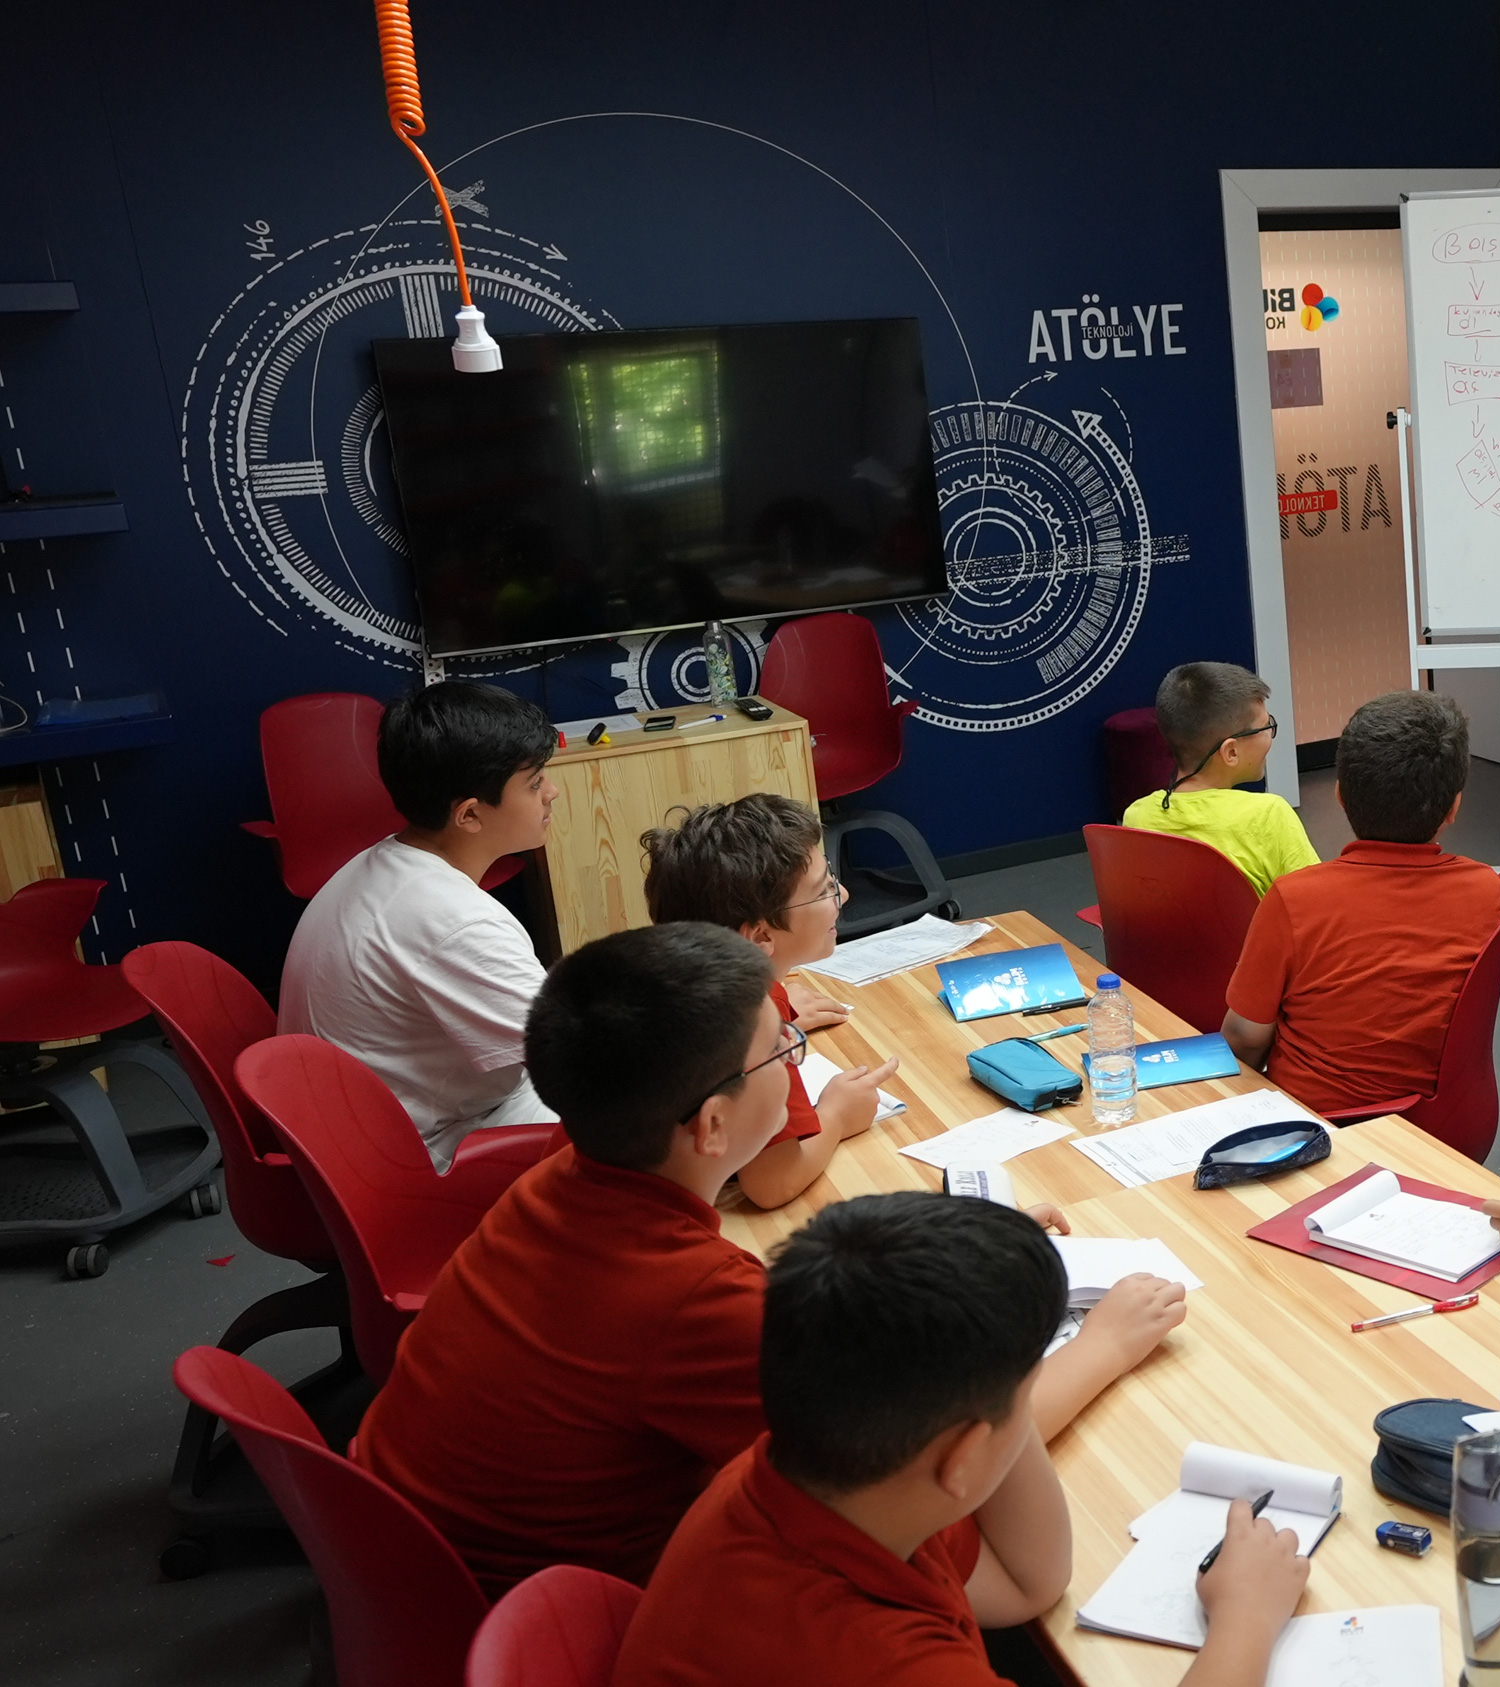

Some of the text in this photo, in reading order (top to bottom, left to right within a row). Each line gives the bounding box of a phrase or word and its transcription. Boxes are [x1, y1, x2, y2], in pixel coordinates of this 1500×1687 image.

[243, 220, 276, 260] 146
[1028, 294, 1187, 363] ATÖLYE
[1081, 322, 1134, 339] TEKNOLOJİ
